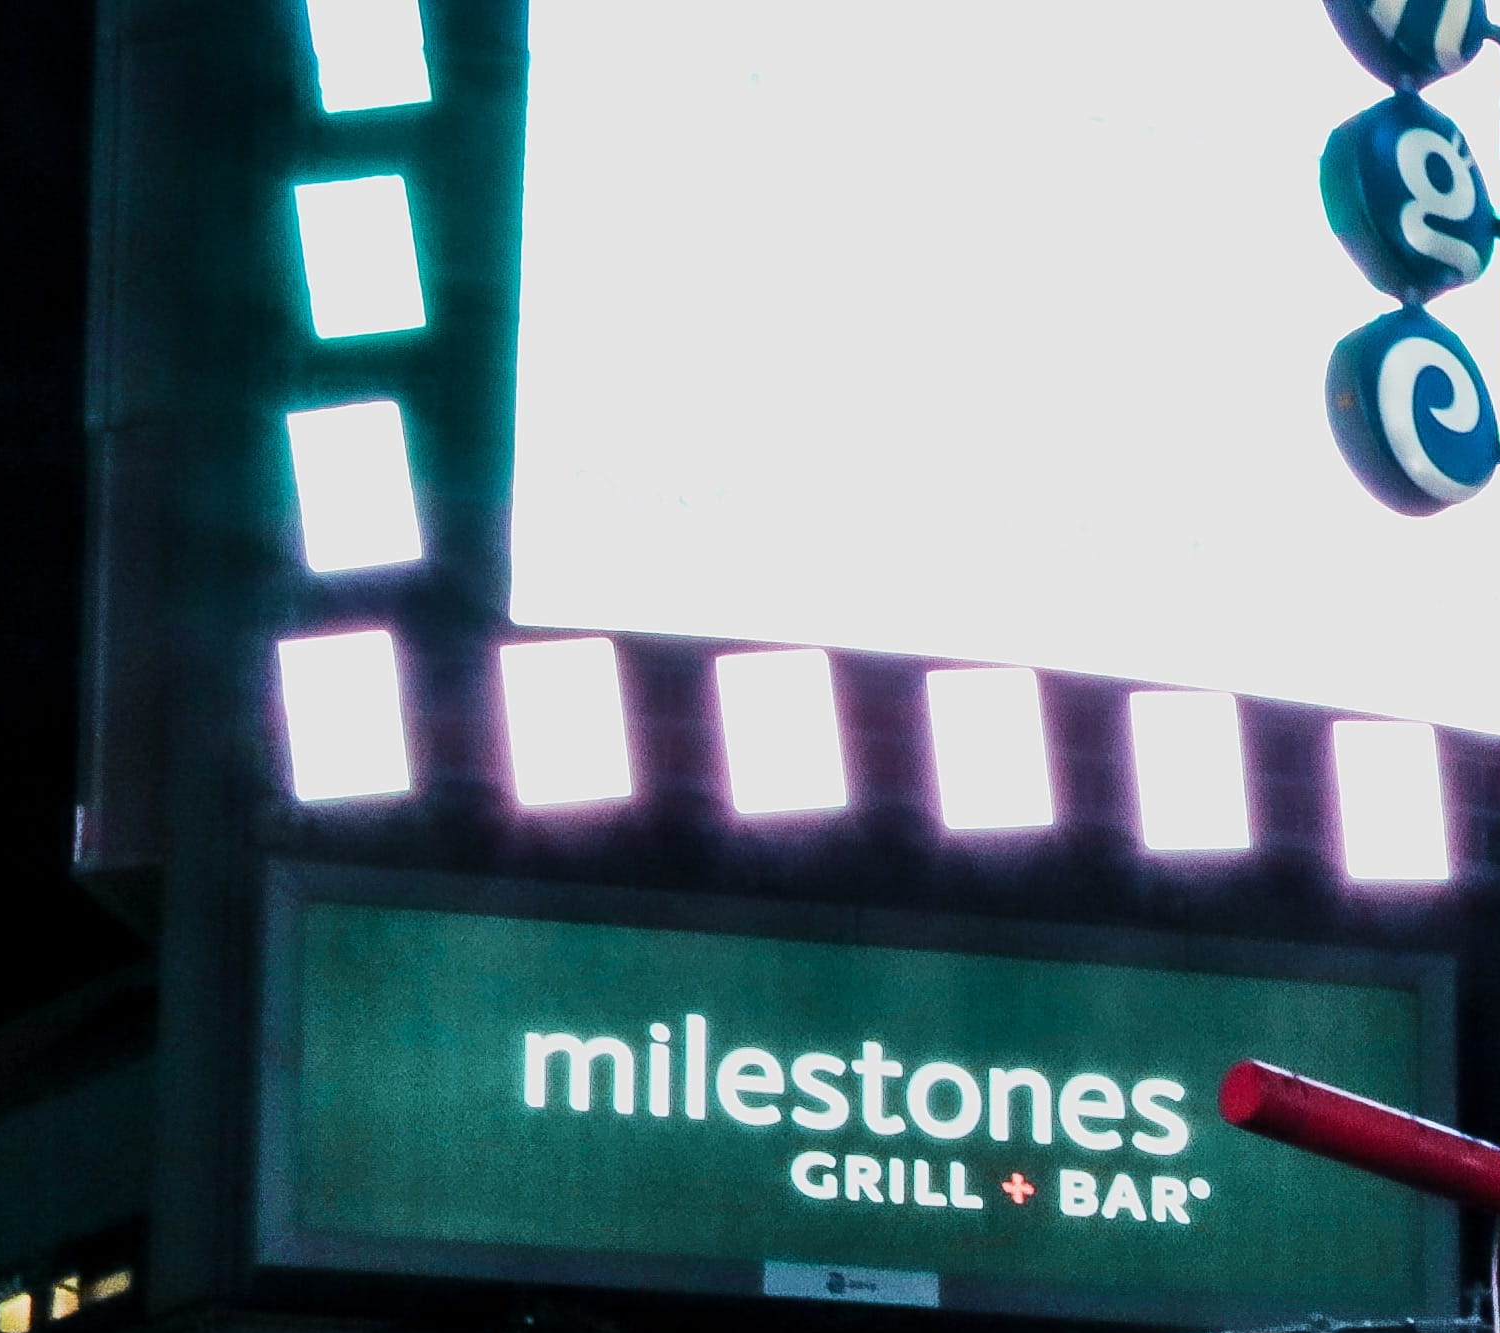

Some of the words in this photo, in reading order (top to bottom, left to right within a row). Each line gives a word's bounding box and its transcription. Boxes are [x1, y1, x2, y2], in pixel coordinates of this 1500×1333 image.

[523, 1013, 1191, 1156] milestones
[790, 1149, 985, 1212] GRILL
[1058, 1167, 1192, 1225] BAR
